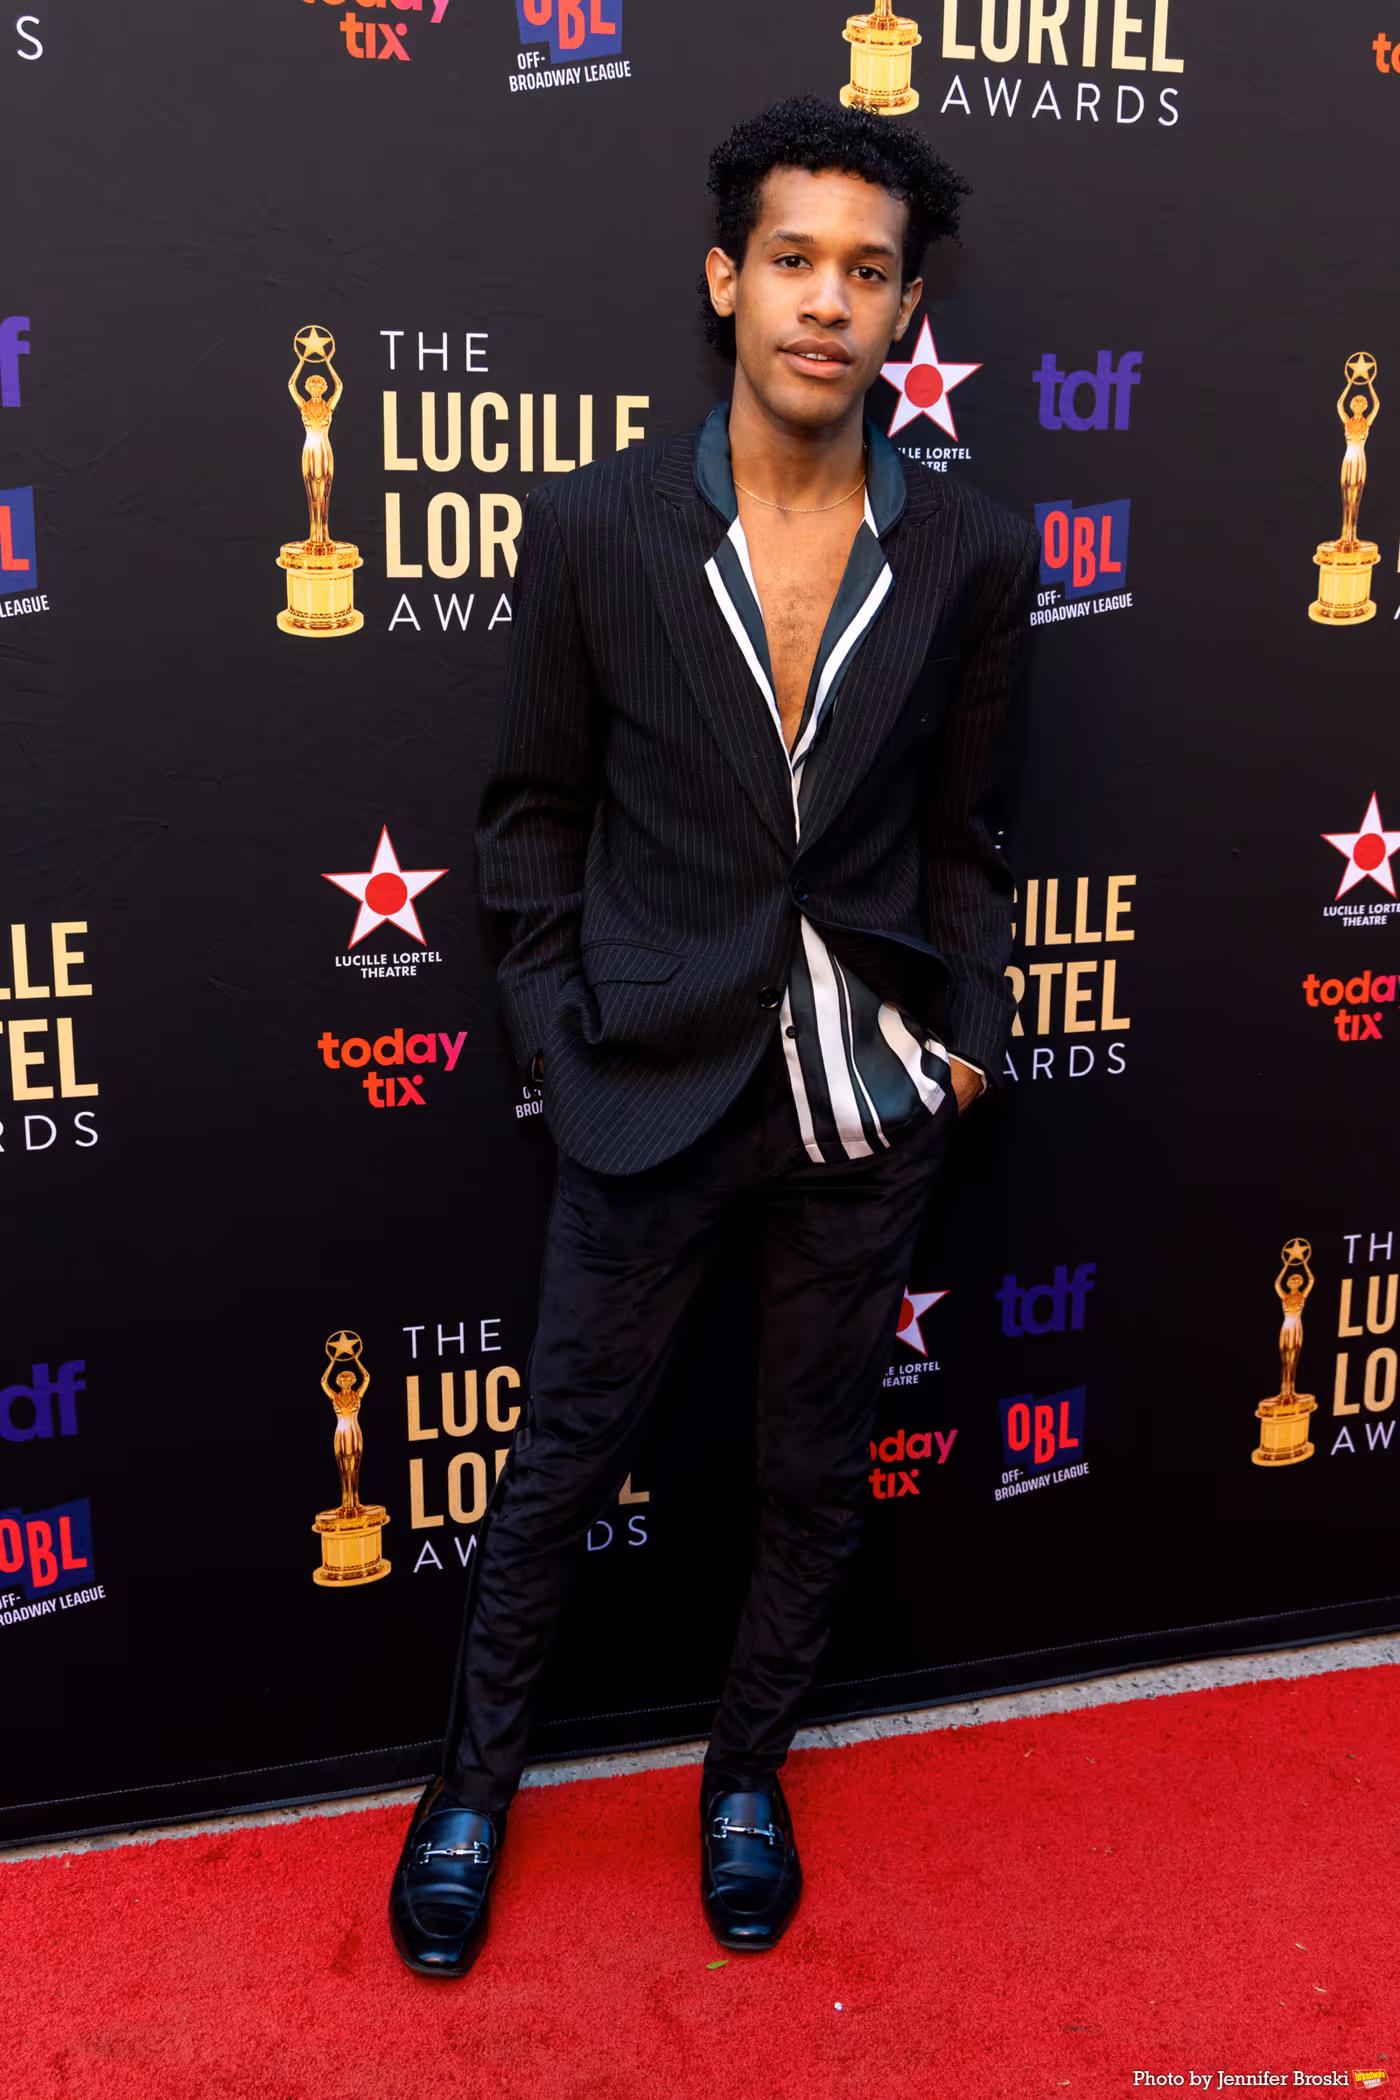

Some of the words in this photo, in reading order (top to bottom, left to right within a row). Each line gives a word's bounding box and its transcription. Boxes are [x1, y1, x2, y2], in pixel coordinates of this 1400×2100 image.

[339, 12, 411, 61] tix
[509, 67, 581, 92] BROADWAY
[584, 60, 632, 83] LEAGUE
[517, 51, 546, 70] OFF-
[940, 75, 1179, 126] AWARDS
[380, 330, 489, 373] THE
[1032, 350, 1144, 431] tdf
[926, 447, 972, 460] LORTEL
[1044, 510, 1122, 588] OBL
[1030, 601, 1091, 626] BROADWAY
[1093, 593, 1134, 614] LEAGUE
[1037, 590, 1062, 607] OFF-
[1323, 904, 1365, 917] LUCILLE
[1342, 915, 1388, 928] THEATRE
[335, 954, 388, 967] LUCILLE
[393, 951, 443, 965] LORTEL
[360, 965, 417, 979] THEATRE
[1302, 970, 1400, 1010] toda
[1333, 1008, 1383, 1042] tix
[317, 1028, 468, 1072] today
[362, 1071, 427, 1108] tix
[995, 1262, 1097, 1337] tdf
[402, 1318, 502, 1359] THE
[899, 1360, 941, 1375] LORTEL
[1007, 1401, 1079, 1465] OBL
[868, 1468, 921, 1500] tix
[994, 1473, 1051, 1502] BROADWAY
[1052, 1462, 1090, 1484] LEAGUE
[1001, 1468, 1024, 1485] OFF-
[59, 1585, 106, 1610] LEAGUE
